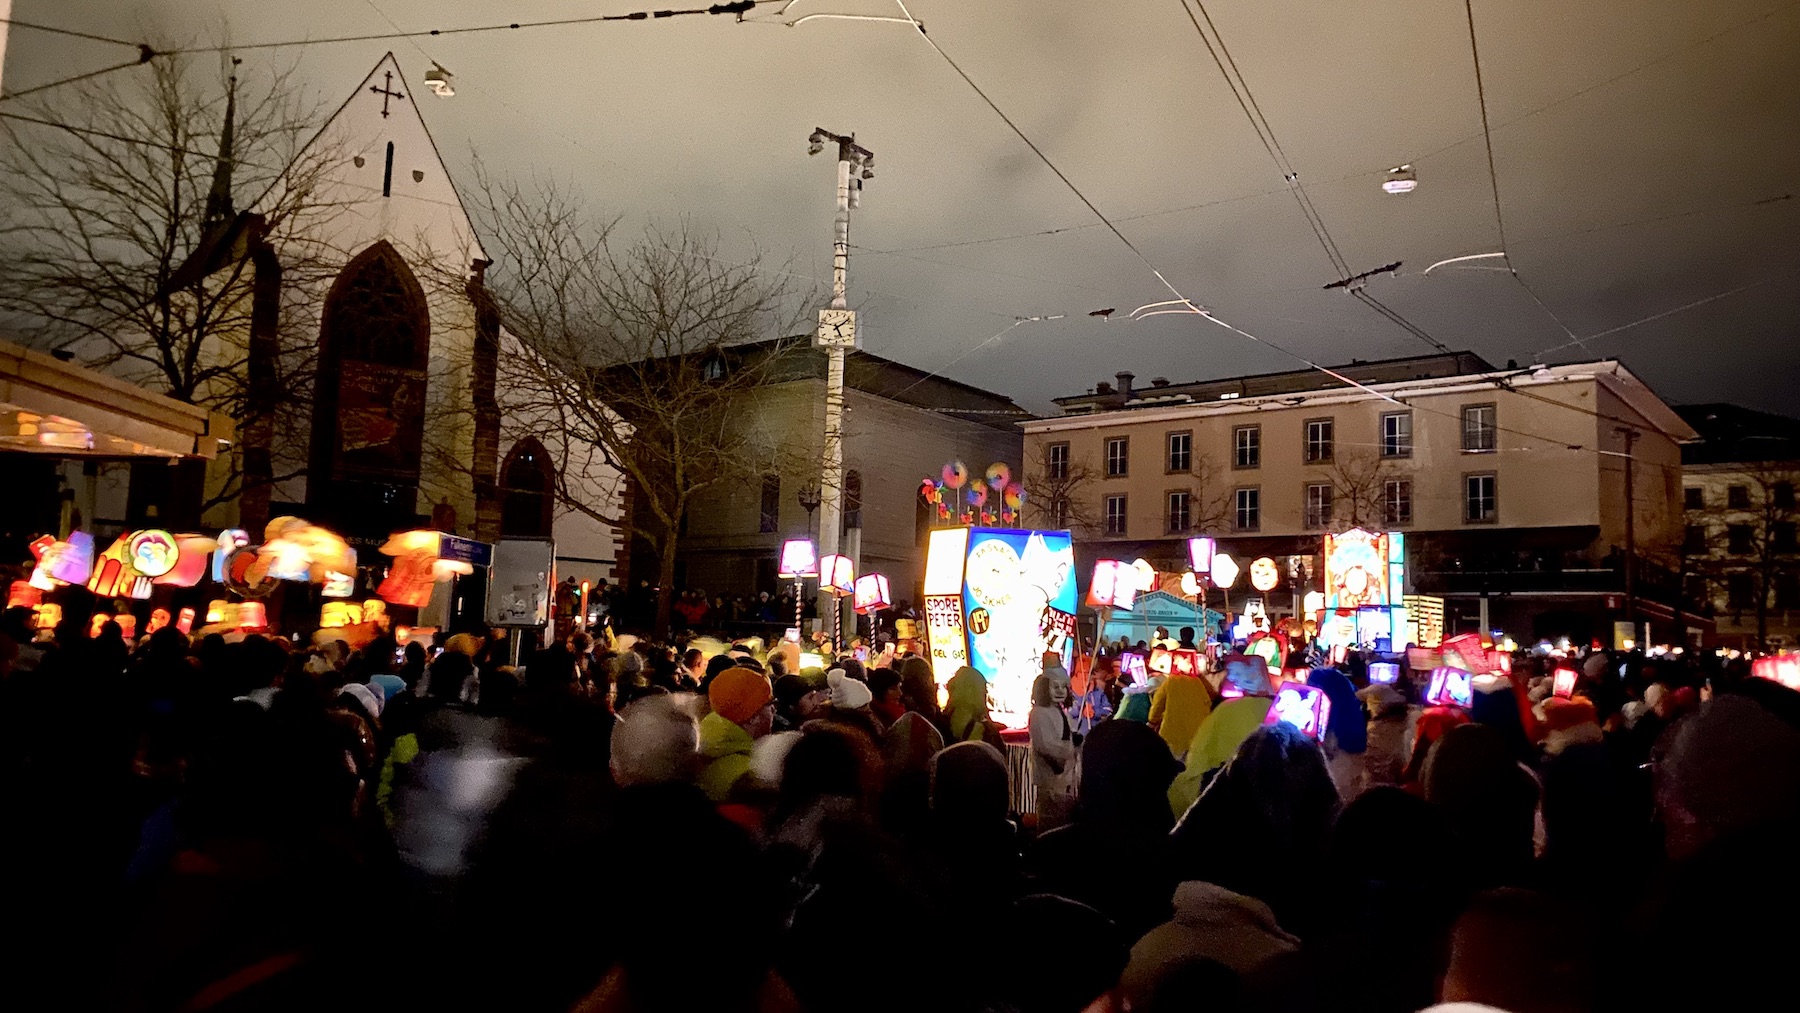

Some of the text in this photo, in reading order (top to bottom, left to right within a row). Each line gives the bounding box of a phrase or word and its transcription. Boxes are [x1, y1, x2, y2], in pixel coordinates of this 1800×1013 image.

[975, 543, 1016, 564] FASNACH
[926, 598, 959, 612] SPORE
[928, 612, 961, 628] PETER
